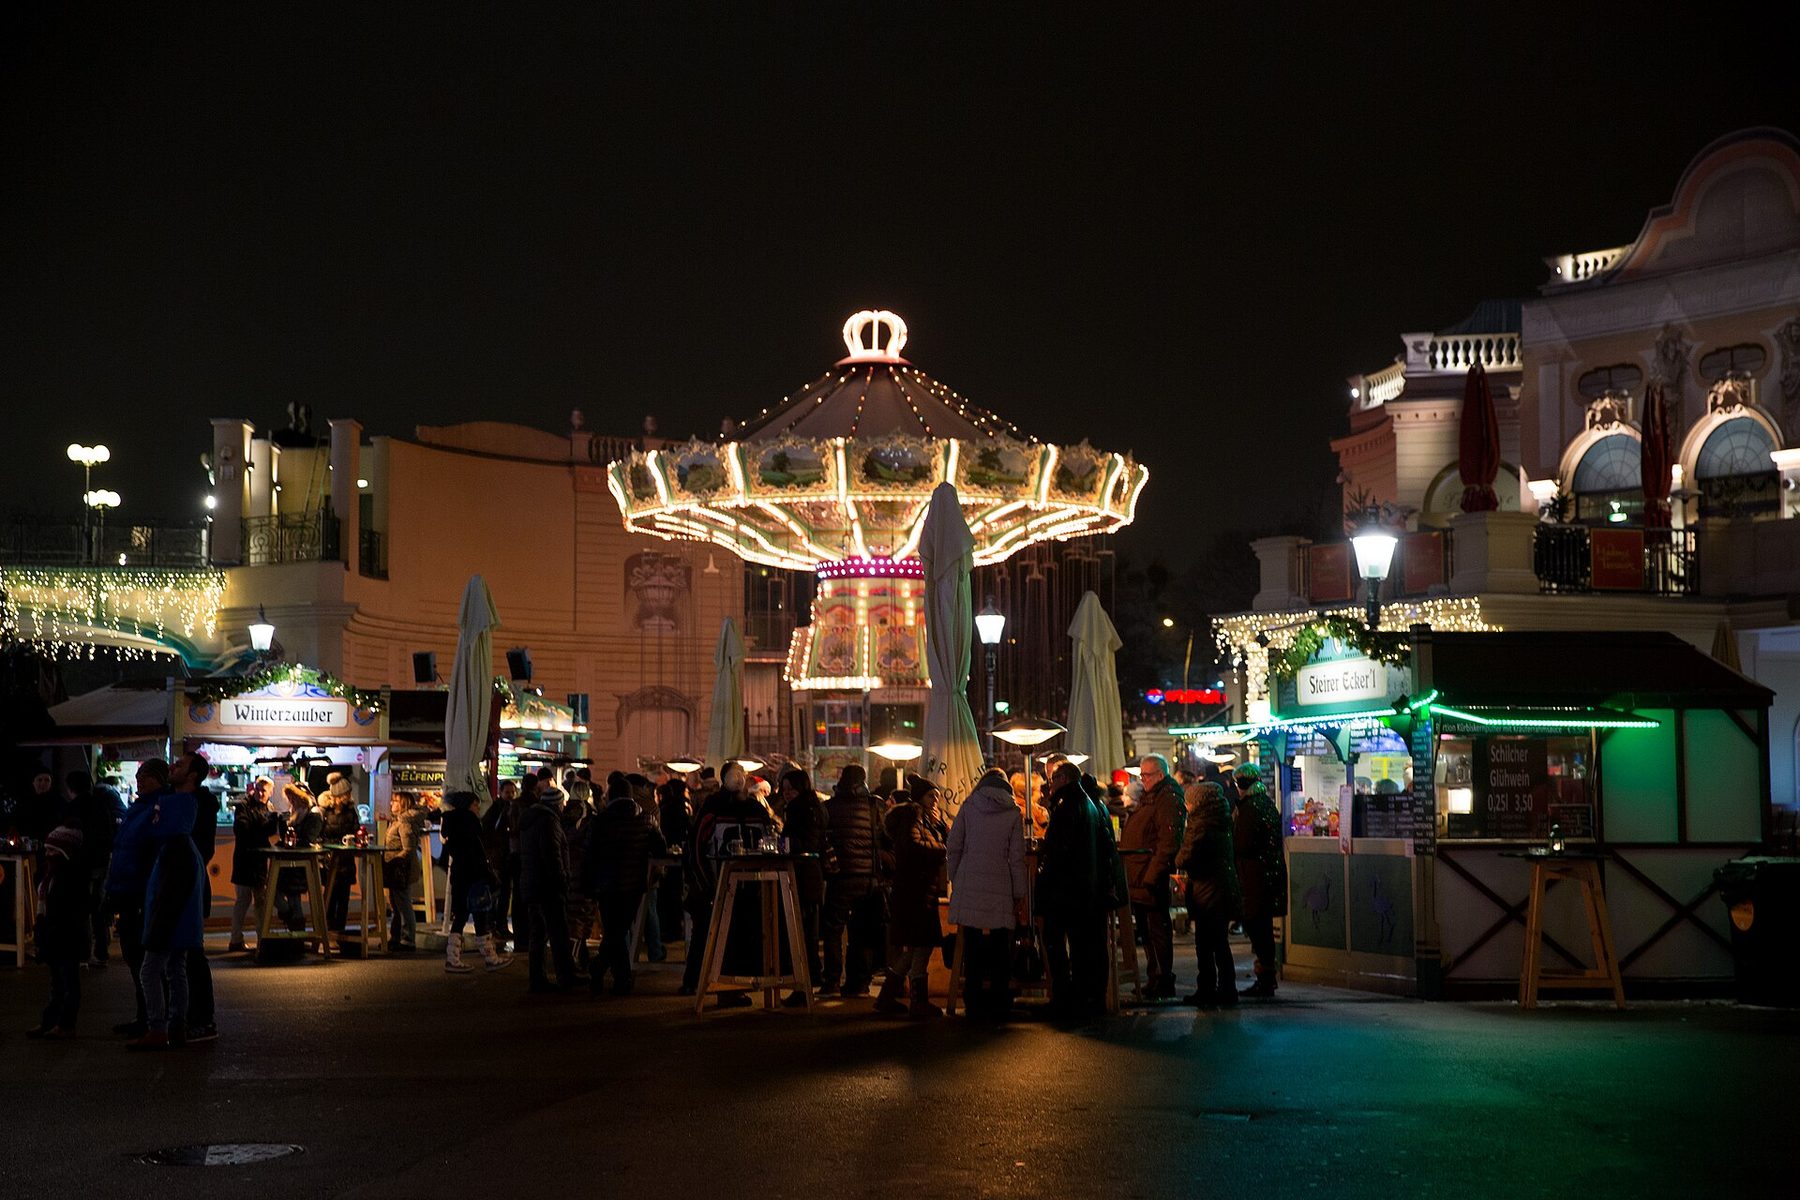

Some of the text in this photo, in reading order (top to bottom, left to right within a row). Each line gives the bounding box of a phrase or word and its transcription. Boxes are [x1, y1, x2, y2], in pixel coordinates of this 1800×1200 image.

[1309, 675, 1340, 695] Steirer
[233, 703, 333, 723] Winterzauber
[1490, 744, 1529, 763] Schilcher
[1489, 768, 1530, 787] Glühwein
[1514, 794, 1533, 812] 3,50
